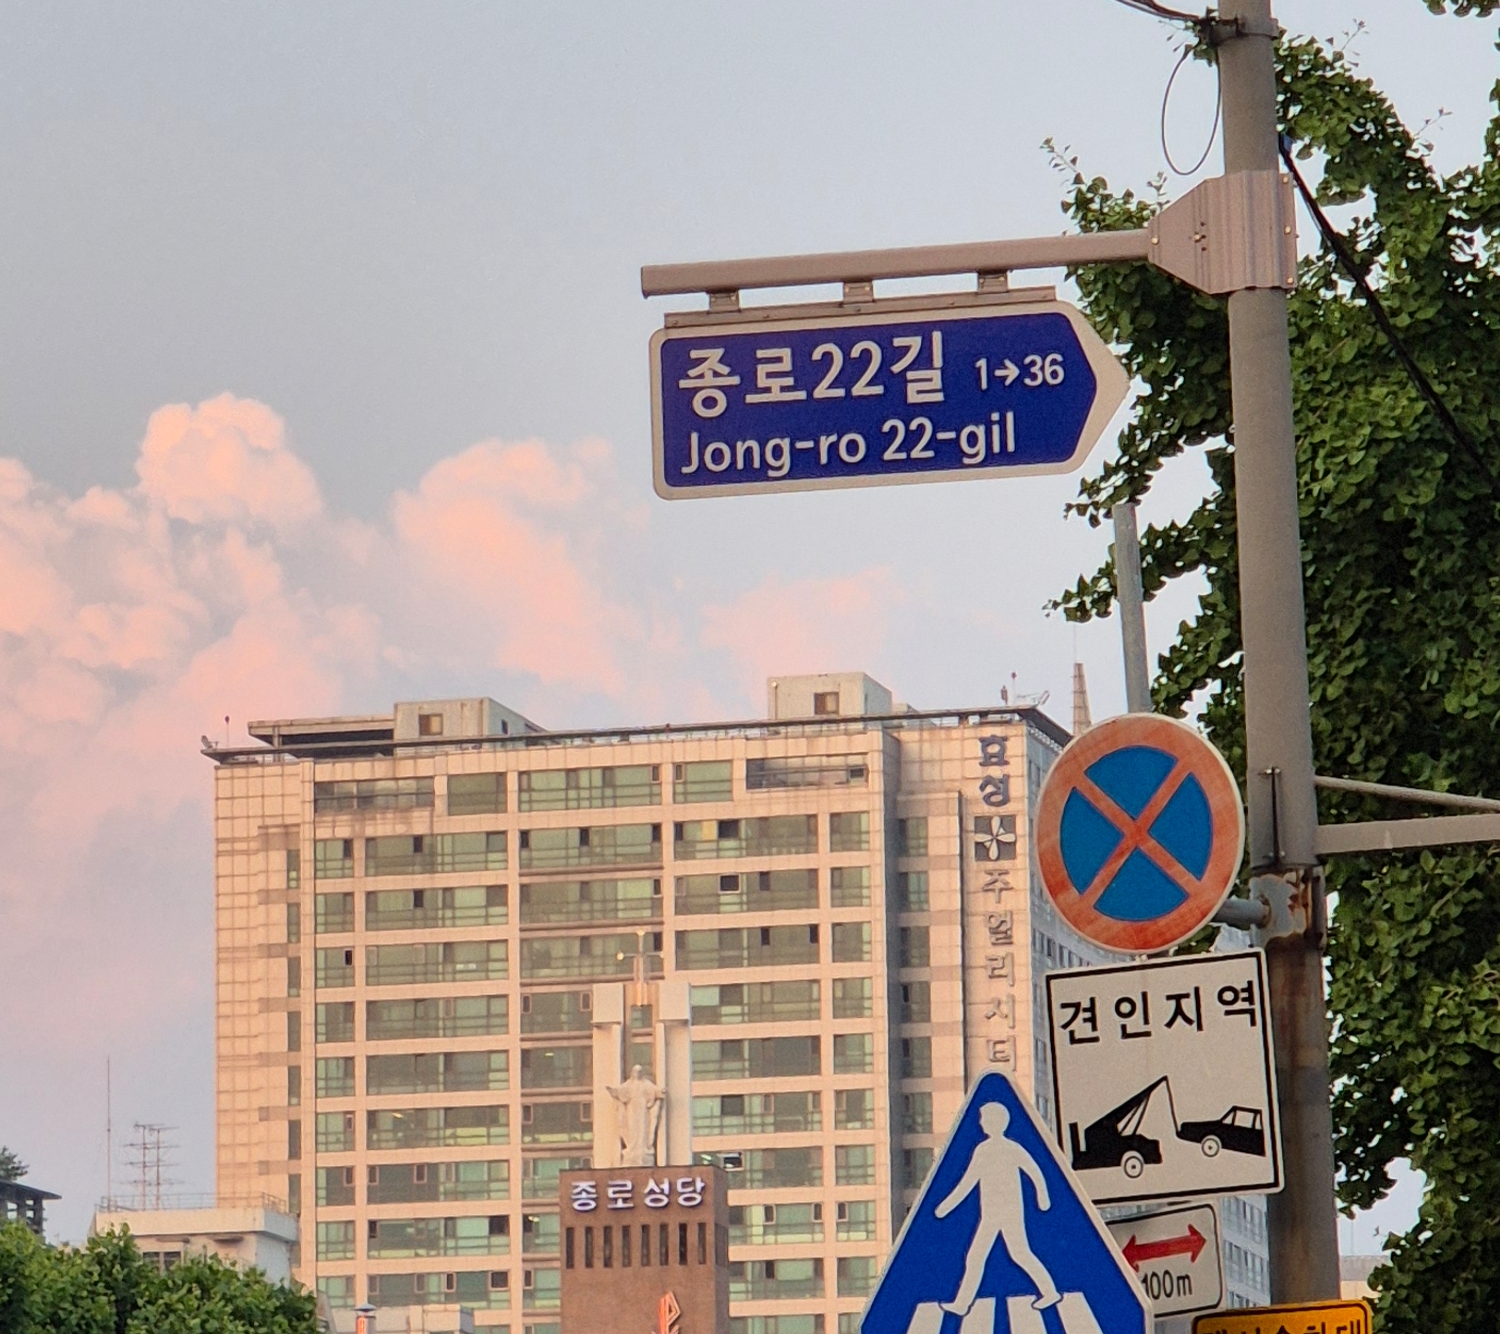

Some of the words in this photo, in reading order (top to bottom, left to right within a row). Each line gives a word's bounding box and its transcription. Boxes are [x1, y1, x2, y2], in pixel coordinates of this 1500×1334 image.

[677, 329, 946, 419] 종로22길
[680, 430, 867, 478] Jong-ro
[881, 411, 1017, 465] 22-gil
[978, 734, 1011, 808] 효성
[1059, 980, 1258, 1046] 견인지역
[570, 1176, 707, 1212] 종로성당
[1140, 1269, 1194, 1301] 100m
